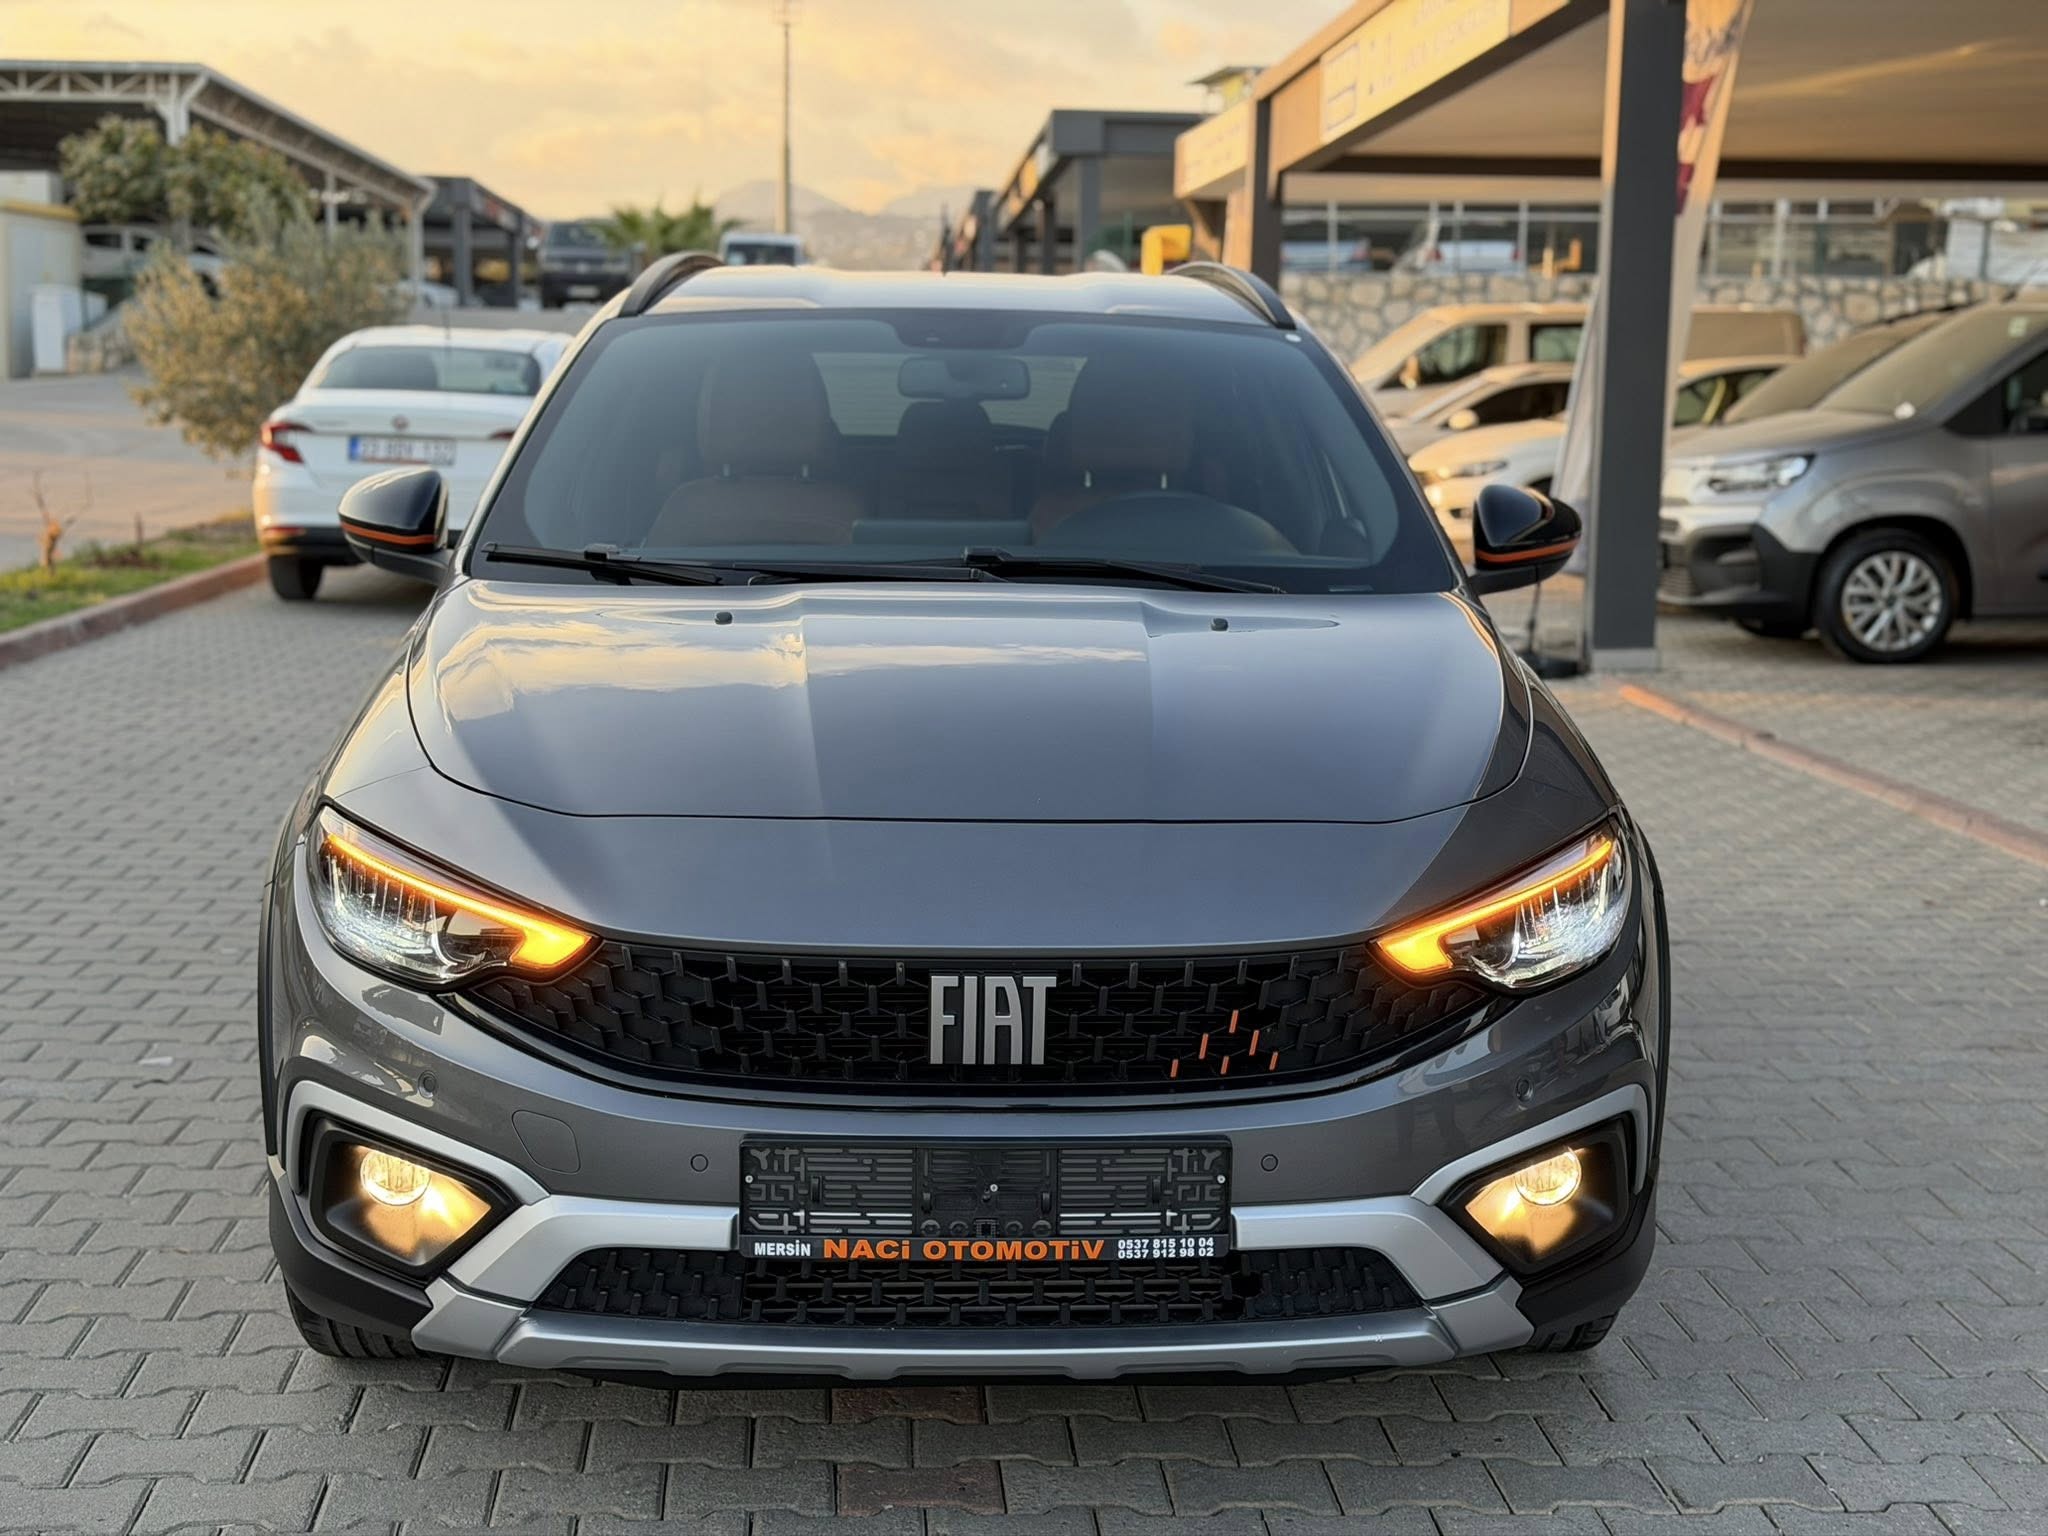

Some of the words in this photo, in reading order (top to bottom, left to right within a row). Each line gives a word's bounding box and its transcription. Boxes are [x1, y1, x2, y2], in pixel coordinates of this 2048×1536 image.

[930, 976, 1057, 1065] FIAT
[1118, 1239, 1149, 1249] 0537
[1153, 1238, 1176, 1248] 815
[1180, 1238, 1195, 1248] 10
[1199, 1237, 1214, 1247] 04
[1118, 1249, 1149, 1259] 0537
[1153, 1248, 1176, 1258] 912
[1180, 1248, 1195, 1257] 98
[1199, 1247, 1214, 1257] 02
